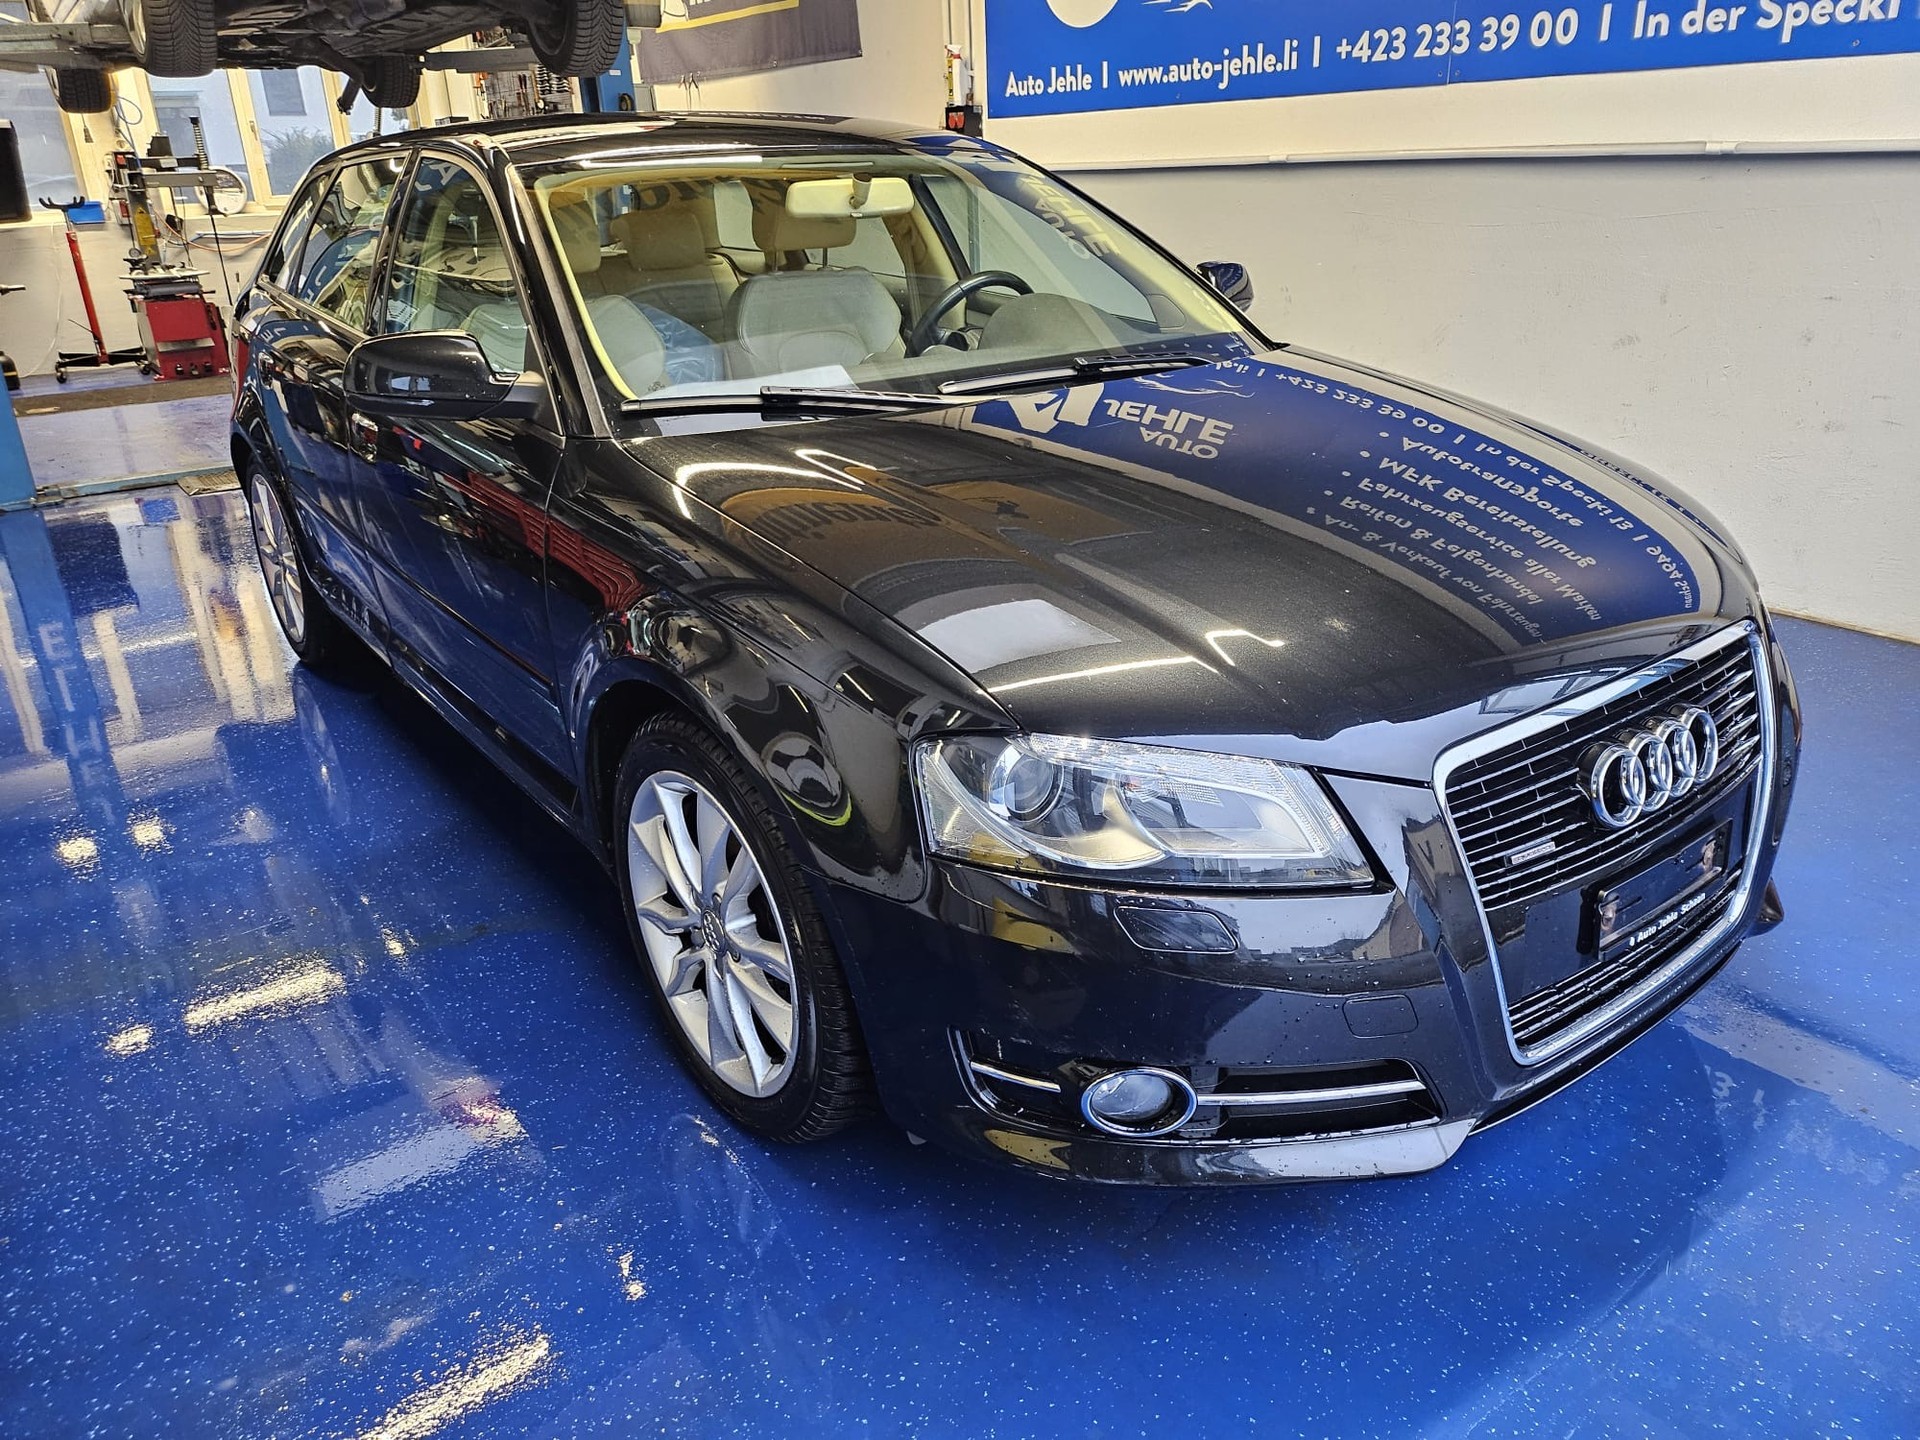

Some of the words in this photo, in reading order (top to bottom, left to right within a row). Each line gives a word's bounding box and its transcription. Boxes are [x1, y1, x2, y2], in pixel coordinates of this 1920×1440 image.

[1005, 71, 1044, 97] Auto
[1047, 63, 1092, 93] Jehle
[1118, 38, 1299, 90] www.auto-jehle.li
[1335, 26, 1407, 63] +423
[1413, 19, 1471, 58] 233
[1478, 13, 1521, 51] 39
[1529, 8, 1579, 47] 00
[1633, 0, 1670, 40] In
[1681, 0, 1747, 35] der
[1636, 925, 1657, 943] Auto
